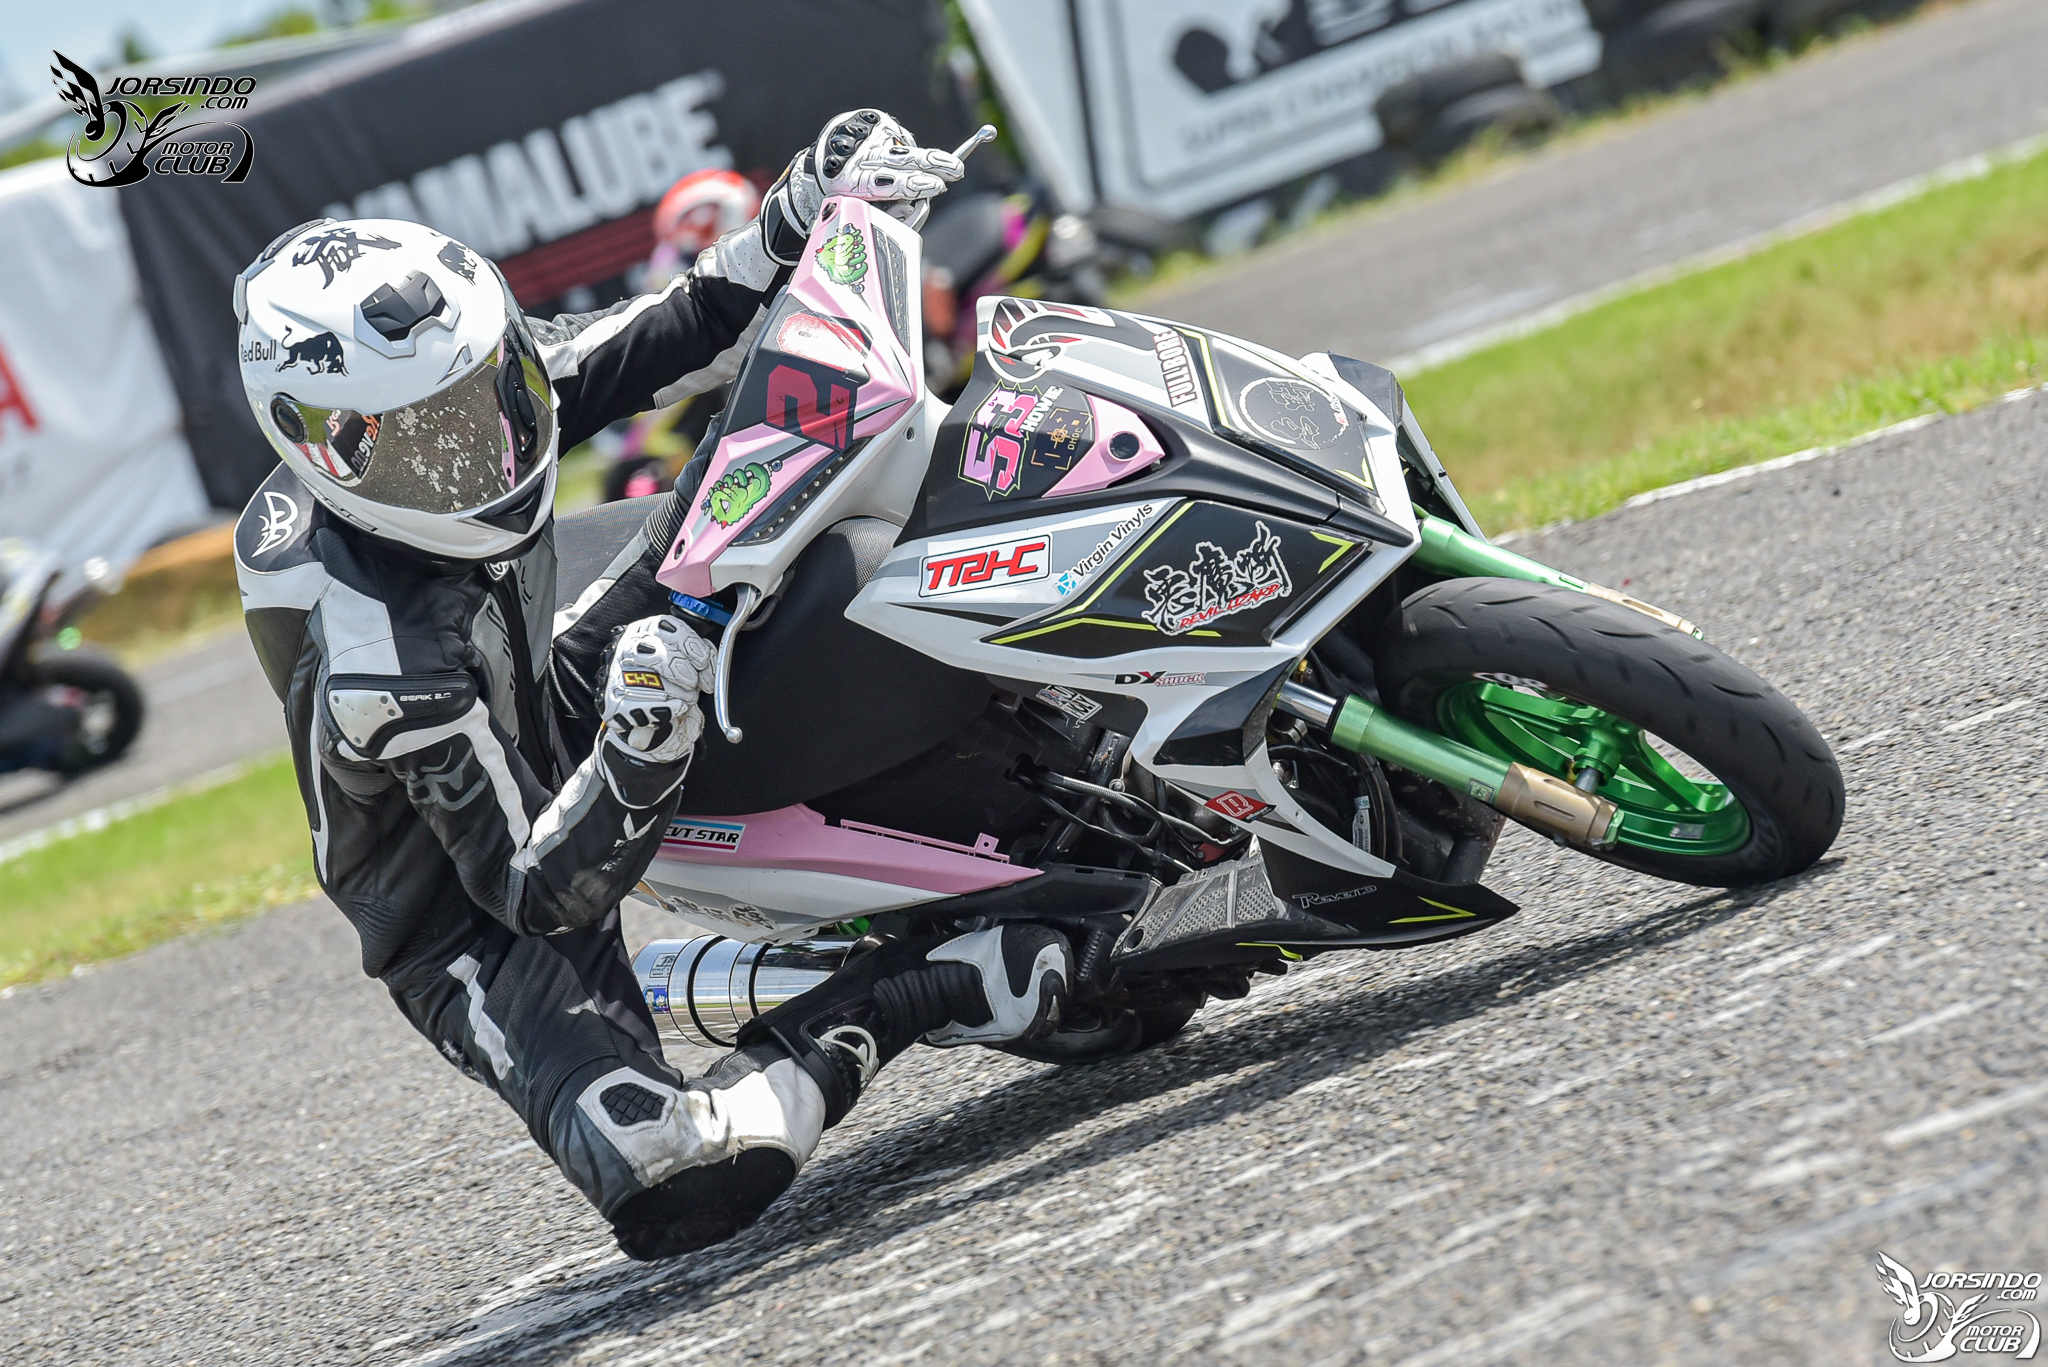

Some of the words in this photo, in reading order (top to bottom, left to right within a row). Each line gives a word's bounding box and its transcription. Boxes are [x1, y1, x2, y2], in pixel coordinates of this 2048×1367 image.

[322, 68, 735, 260] MALUBE
[255, 339, 277, 361] Bull
[1153, 330, 1198, 408] FULLBORE
[1020, 385, 1064, 432] HOWIE
[963, 387, 1038, 491] 53
[1073, 539, 1114, 577] Virgin
[1110, 503, 1153, 543] Vinyls
[1177, 604, 1224, 630] DEVIL
[1227, 583, 1280, 610] LIZARD
[695, 829, 740, 844] STAR
